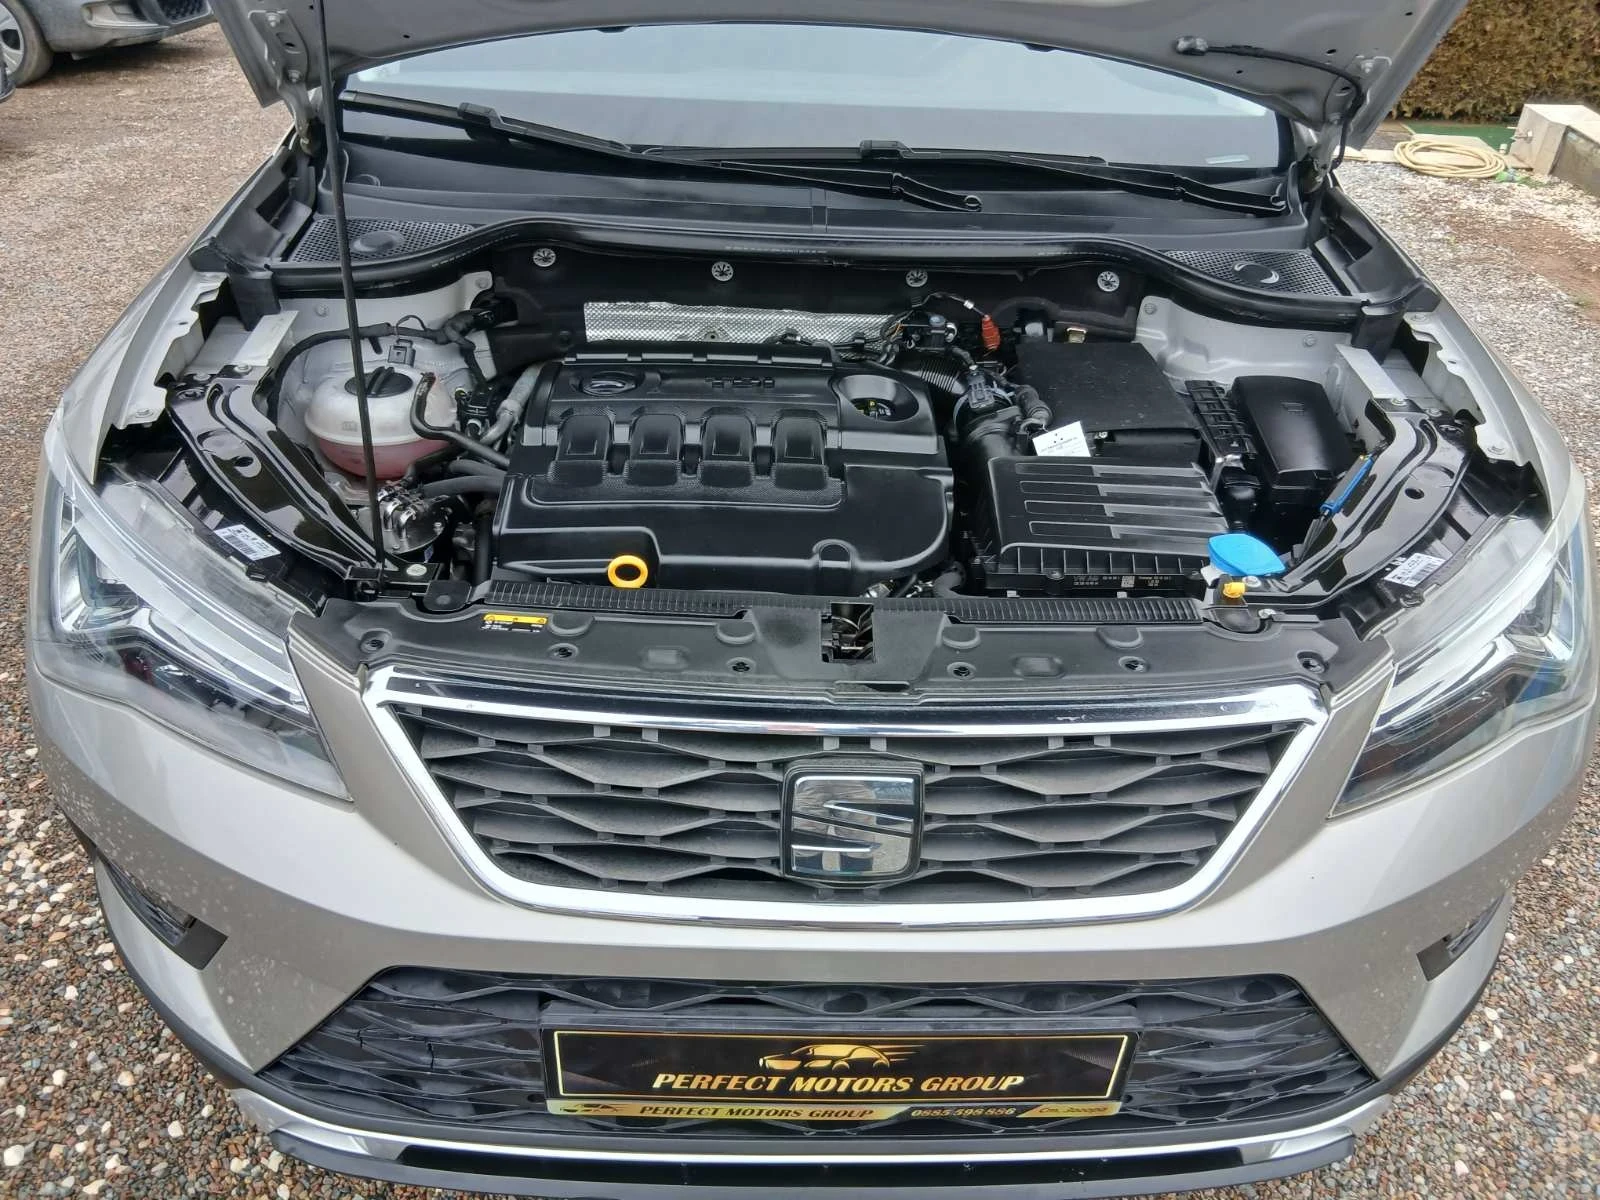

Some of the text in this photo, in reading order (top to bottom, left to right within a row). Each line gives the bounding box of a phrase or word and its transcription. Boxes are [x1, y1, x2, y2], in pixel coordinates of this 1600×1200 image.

[652, 1073, 1025, 1093] PERFECT MOTORS GROUP
[639, 1105, 721, 1117] PERFECT
[727, 1108, 804, 1118] MOTORS
[808, 1108, 874, 1119] GROUP
